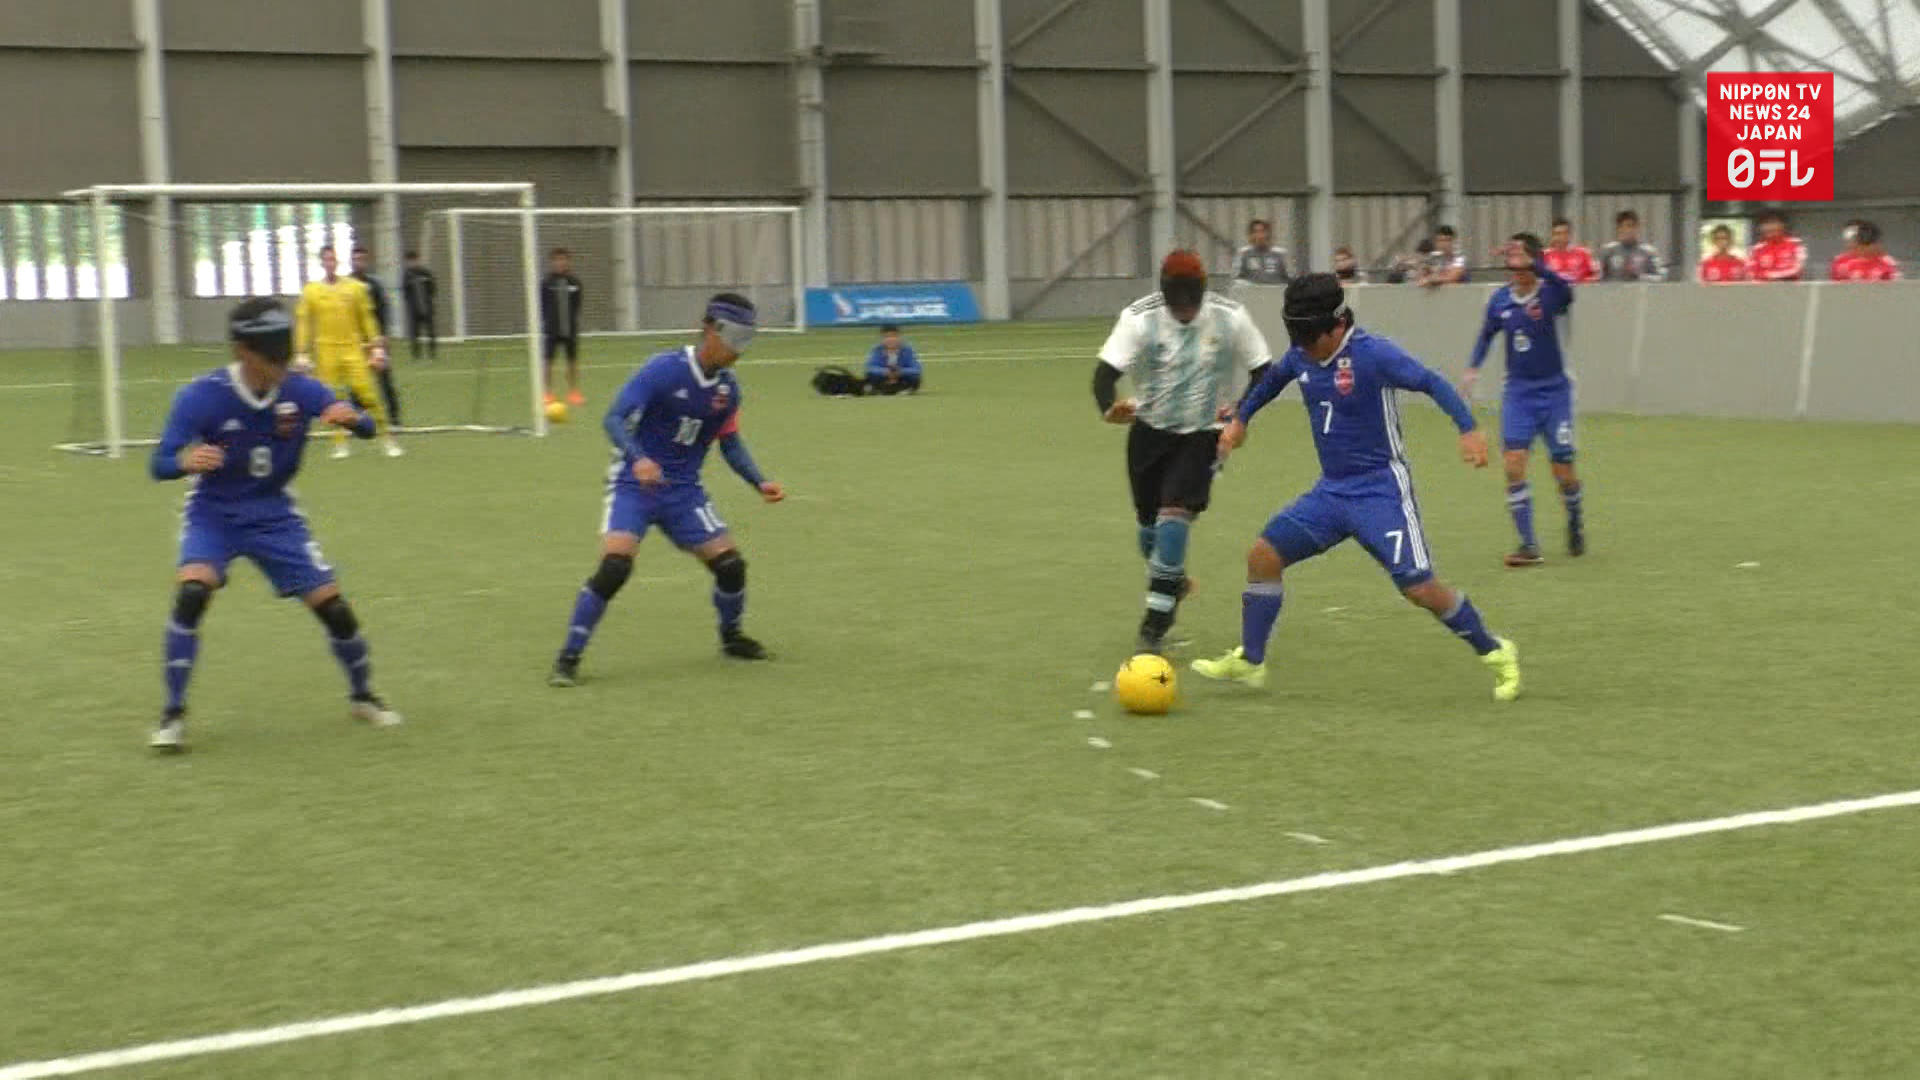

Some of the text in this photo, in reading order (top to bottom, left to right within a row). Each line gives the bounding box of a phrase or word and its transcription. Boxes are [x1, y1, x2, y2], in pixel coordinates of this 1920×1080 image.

[672, 416, 704, 446] 10
[1319, 400, 1333, 434] 7
[1556, 420, 1574, 446] 6
[248, 444, 273, 478] 8
[1384, 530, 1404, 565] 7
